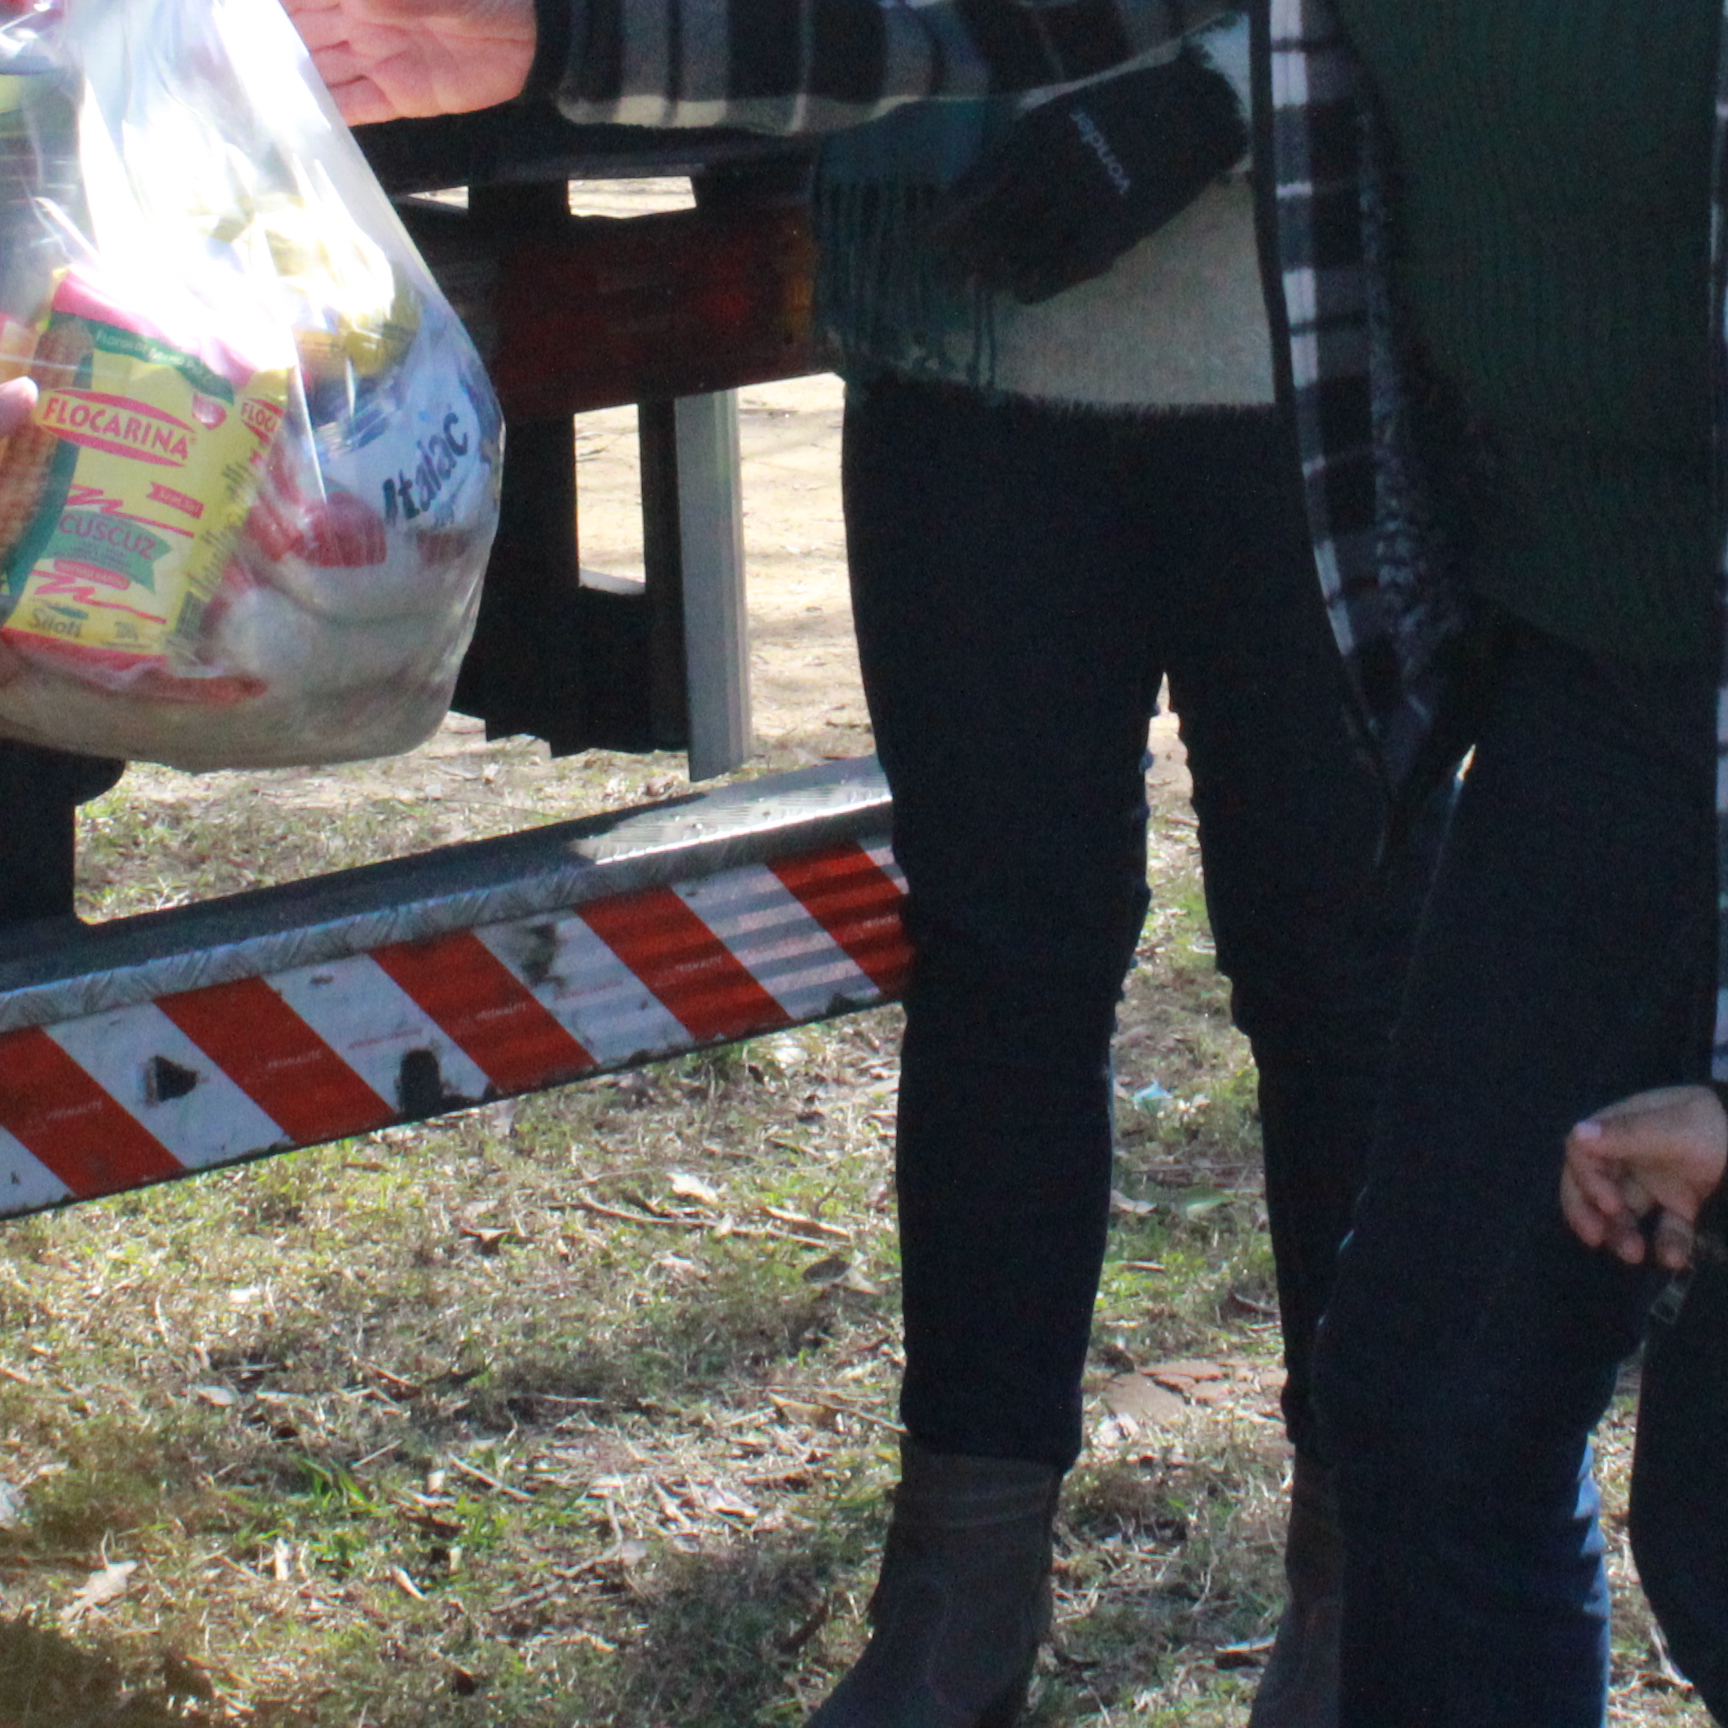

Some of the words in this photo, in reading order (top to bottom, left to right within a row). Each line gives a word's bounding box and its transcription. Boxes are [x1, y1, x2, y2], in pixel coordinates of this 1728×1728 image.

[1069, 112, 1131, 195] vonder
[42, 396, 189, 460] FLOCARINA
[59, 514, 157, 559] CUSCUZ
